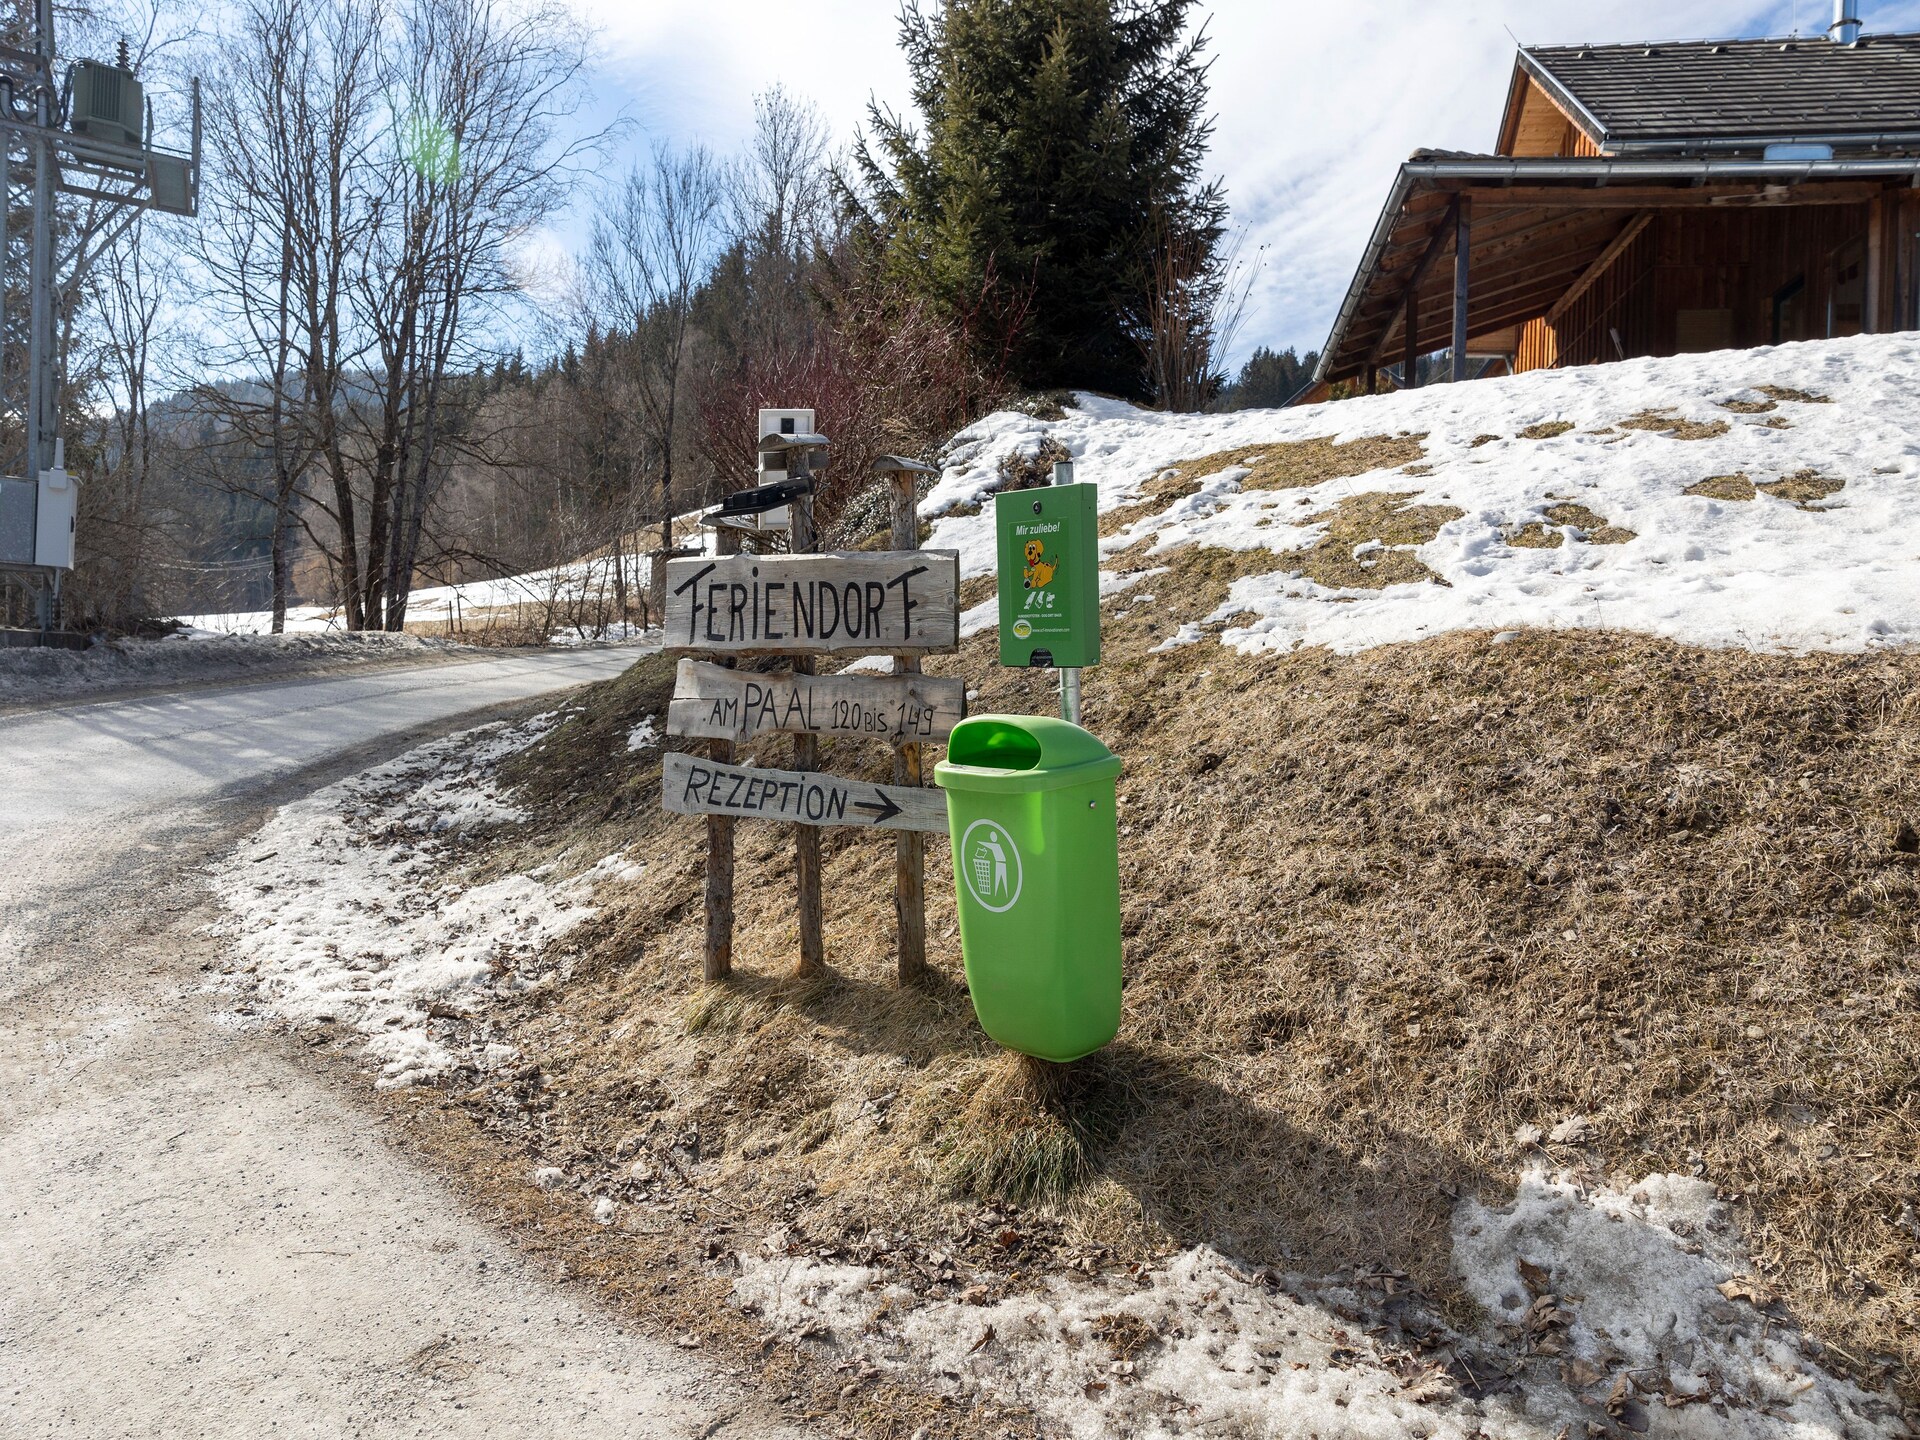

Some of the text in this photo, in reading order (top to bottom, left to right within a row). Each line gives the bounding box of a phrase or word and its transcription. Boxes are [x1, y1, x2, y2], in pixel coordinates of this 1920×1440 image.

[1016, 522, 1060, 536] Mir zuliebe!
[674, 563, 929, 645] FERIENDORF
[709, 698, 738, 727] AM
[743, 682, 821, 731] PAAL
[831, 701, 861, 730] 120
[897, 702, 934, 735] 149
[683, 765, 847, 820] REZEPTION
